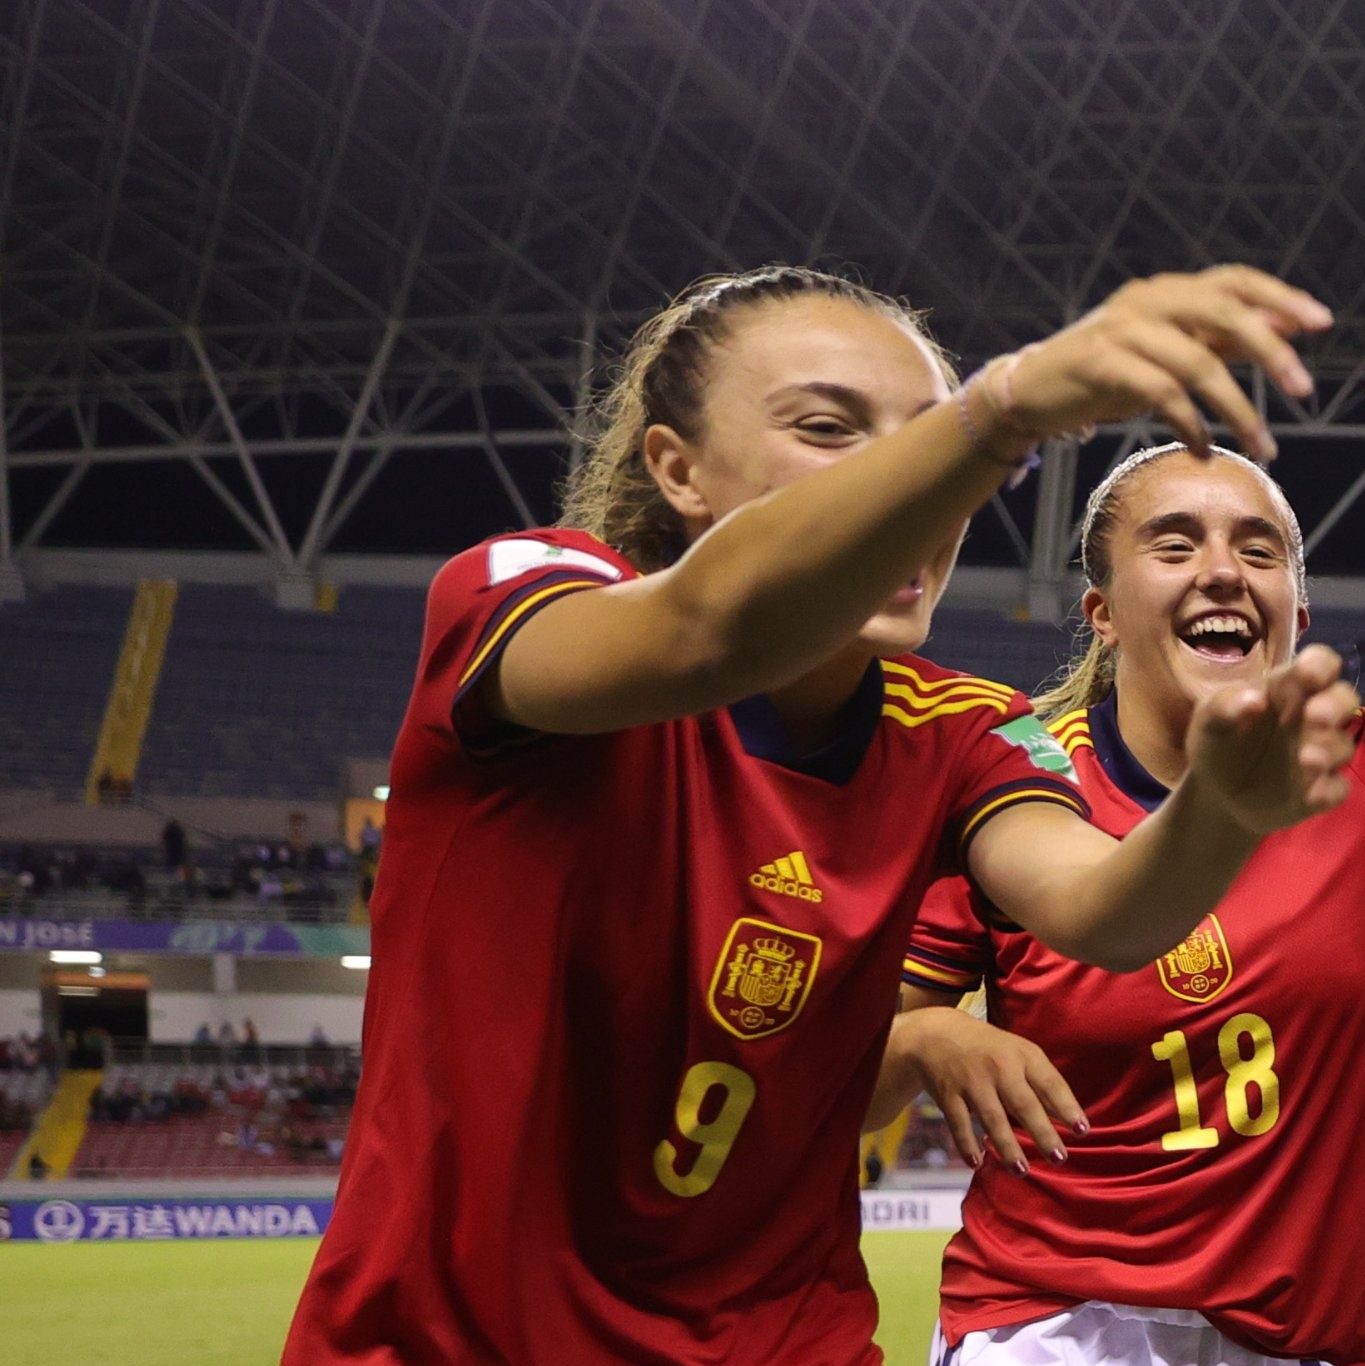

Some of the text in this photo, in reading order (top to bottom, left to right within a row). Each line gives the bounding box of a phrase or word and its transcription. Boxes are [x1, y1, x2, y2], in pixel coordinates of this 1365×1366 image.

[749, 872, 824, 903] adidas
[653, 1060, 756, 1198] 9
[1151, 1012, 1280, 1152] 18
